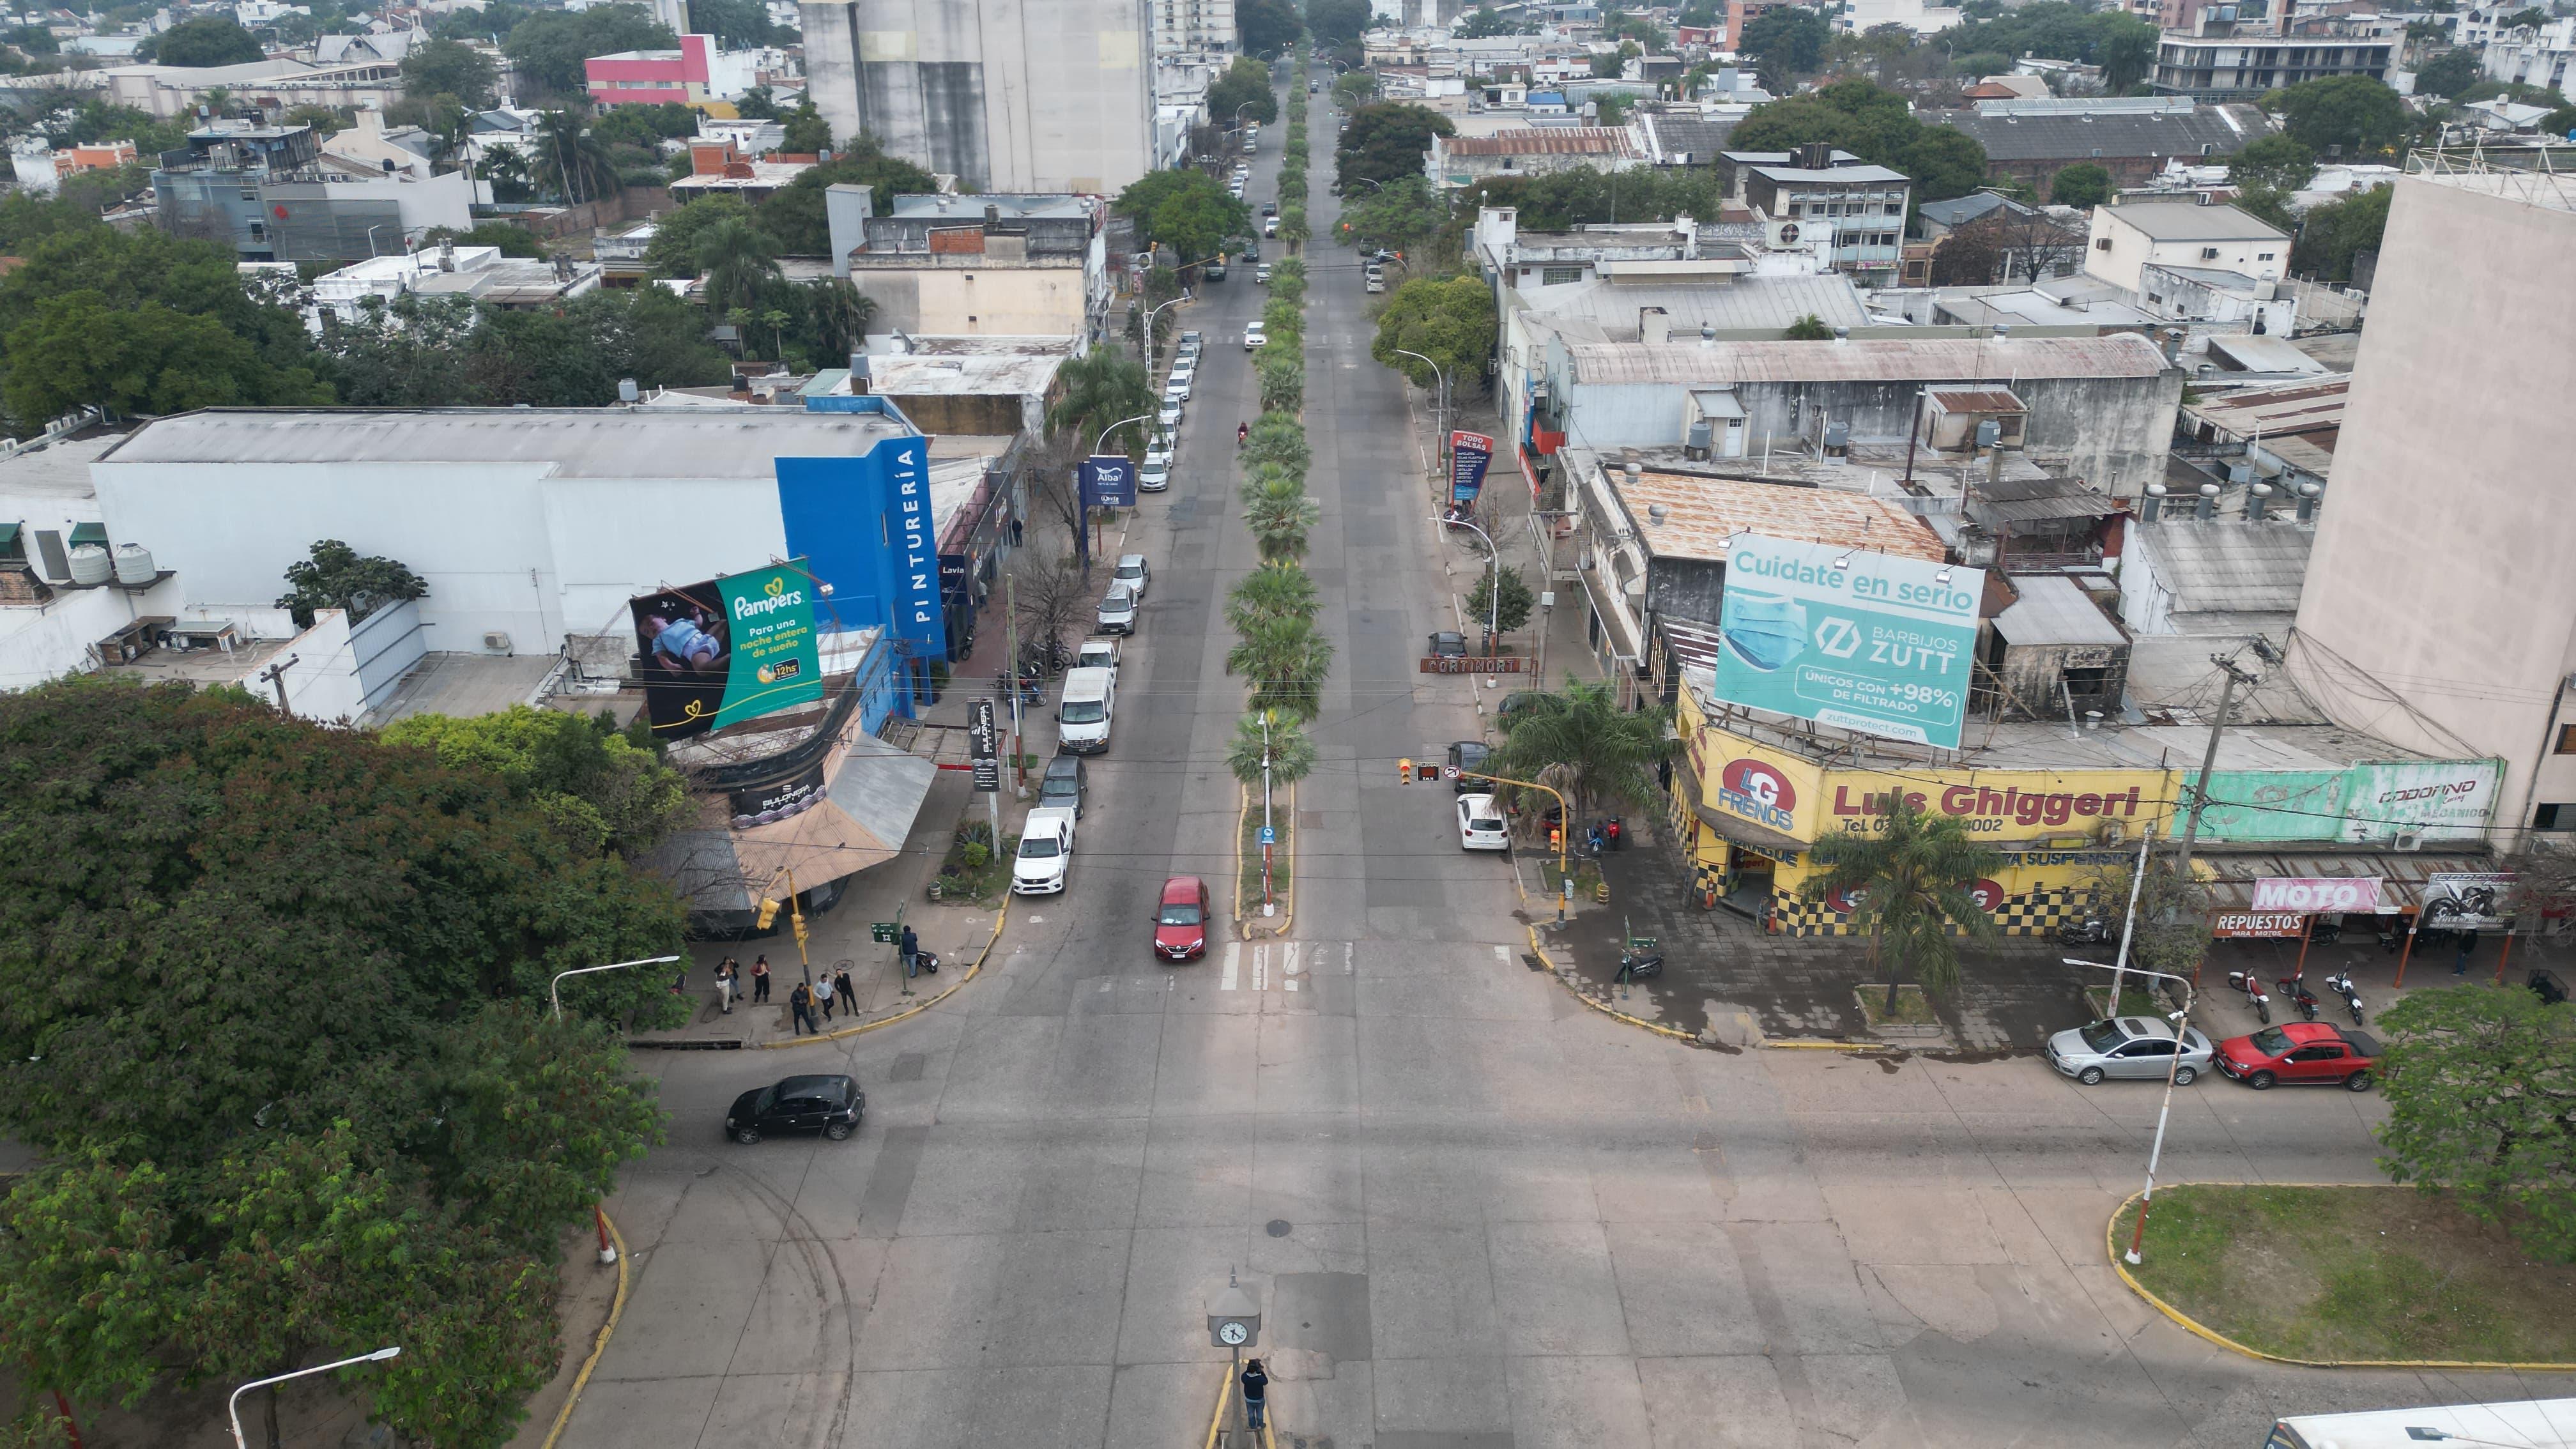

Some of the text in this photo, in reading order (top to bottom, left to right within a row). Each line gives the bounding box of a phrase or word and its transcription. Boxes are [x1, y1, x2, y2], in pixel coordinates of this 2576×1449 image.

[1457, 440, 1486, 450] BOLSAS
[1462, 435, 1483, 443] TODO
[894, 450, 931, 623] PINTURERÍA
[973, 551, 982, 581] Alba
[1735, 551, 1973, 610] Cuidate en serio
[734, 590, 802, 620] Pampers
[740, 627, 808, 650] noche entera
[749, 619, 795, 637] Para una
[1873, 627, 1958, 652] BARBIJOS
[752, 639, 798, 658] de sueño
[1869, 641, 1956, 674] ZUTT
[776, 665, 797, 675] 12hs
[1429, 659, 1514, 672] CORTINORT
[1805, 670, 1952, 708] ÚNICOS CON +98%
[1833, 688, 1918, 713] DE FILTRADO
[1827, 713, 1917, 737] zuttprotect.com
[1740, 767, 1779, 806] LG
[1719, 787, 1793, 831] FRENOS
[1966, 818, 2004, 832] 002
[2257, 883, 2358, 907] MOTO
[2217, 915, 2301, 930] REPUESTOS
